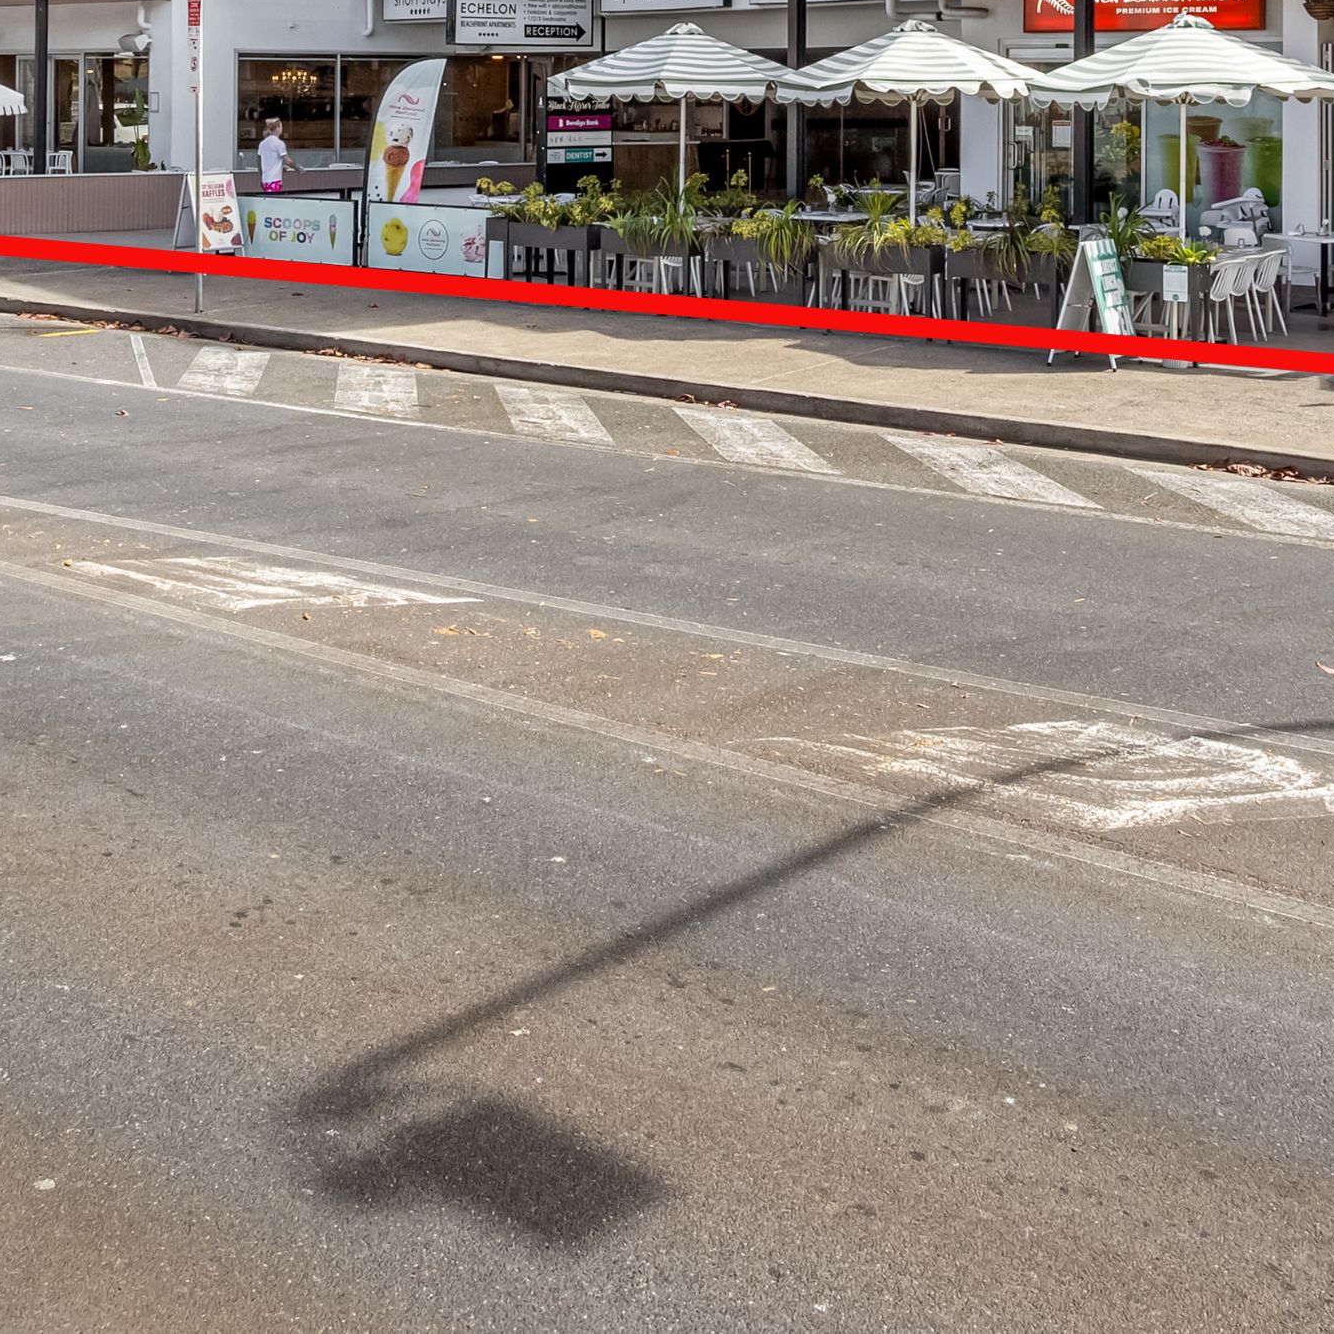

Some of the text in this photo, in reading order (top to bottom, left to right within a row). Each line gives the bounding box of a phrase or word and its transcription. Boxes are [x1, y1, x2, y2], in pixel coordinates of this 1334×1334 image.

[460, 3, 517, 15] ECHELON
[1116, 7, 1160, 15] PREMIUM
[1163, 6, 1179, 14] ICE
[460, 20, 516, 28] BEACHFRONT APARTMENTS
[526, 27, 578, 36] RECEPTION
[547, 100, 566, 111] Black
[566, 119, 586, 127] Bendigo
[264, 217, 321, 231] SCOOPS
[269, 230, 315, 244] OF JOY
